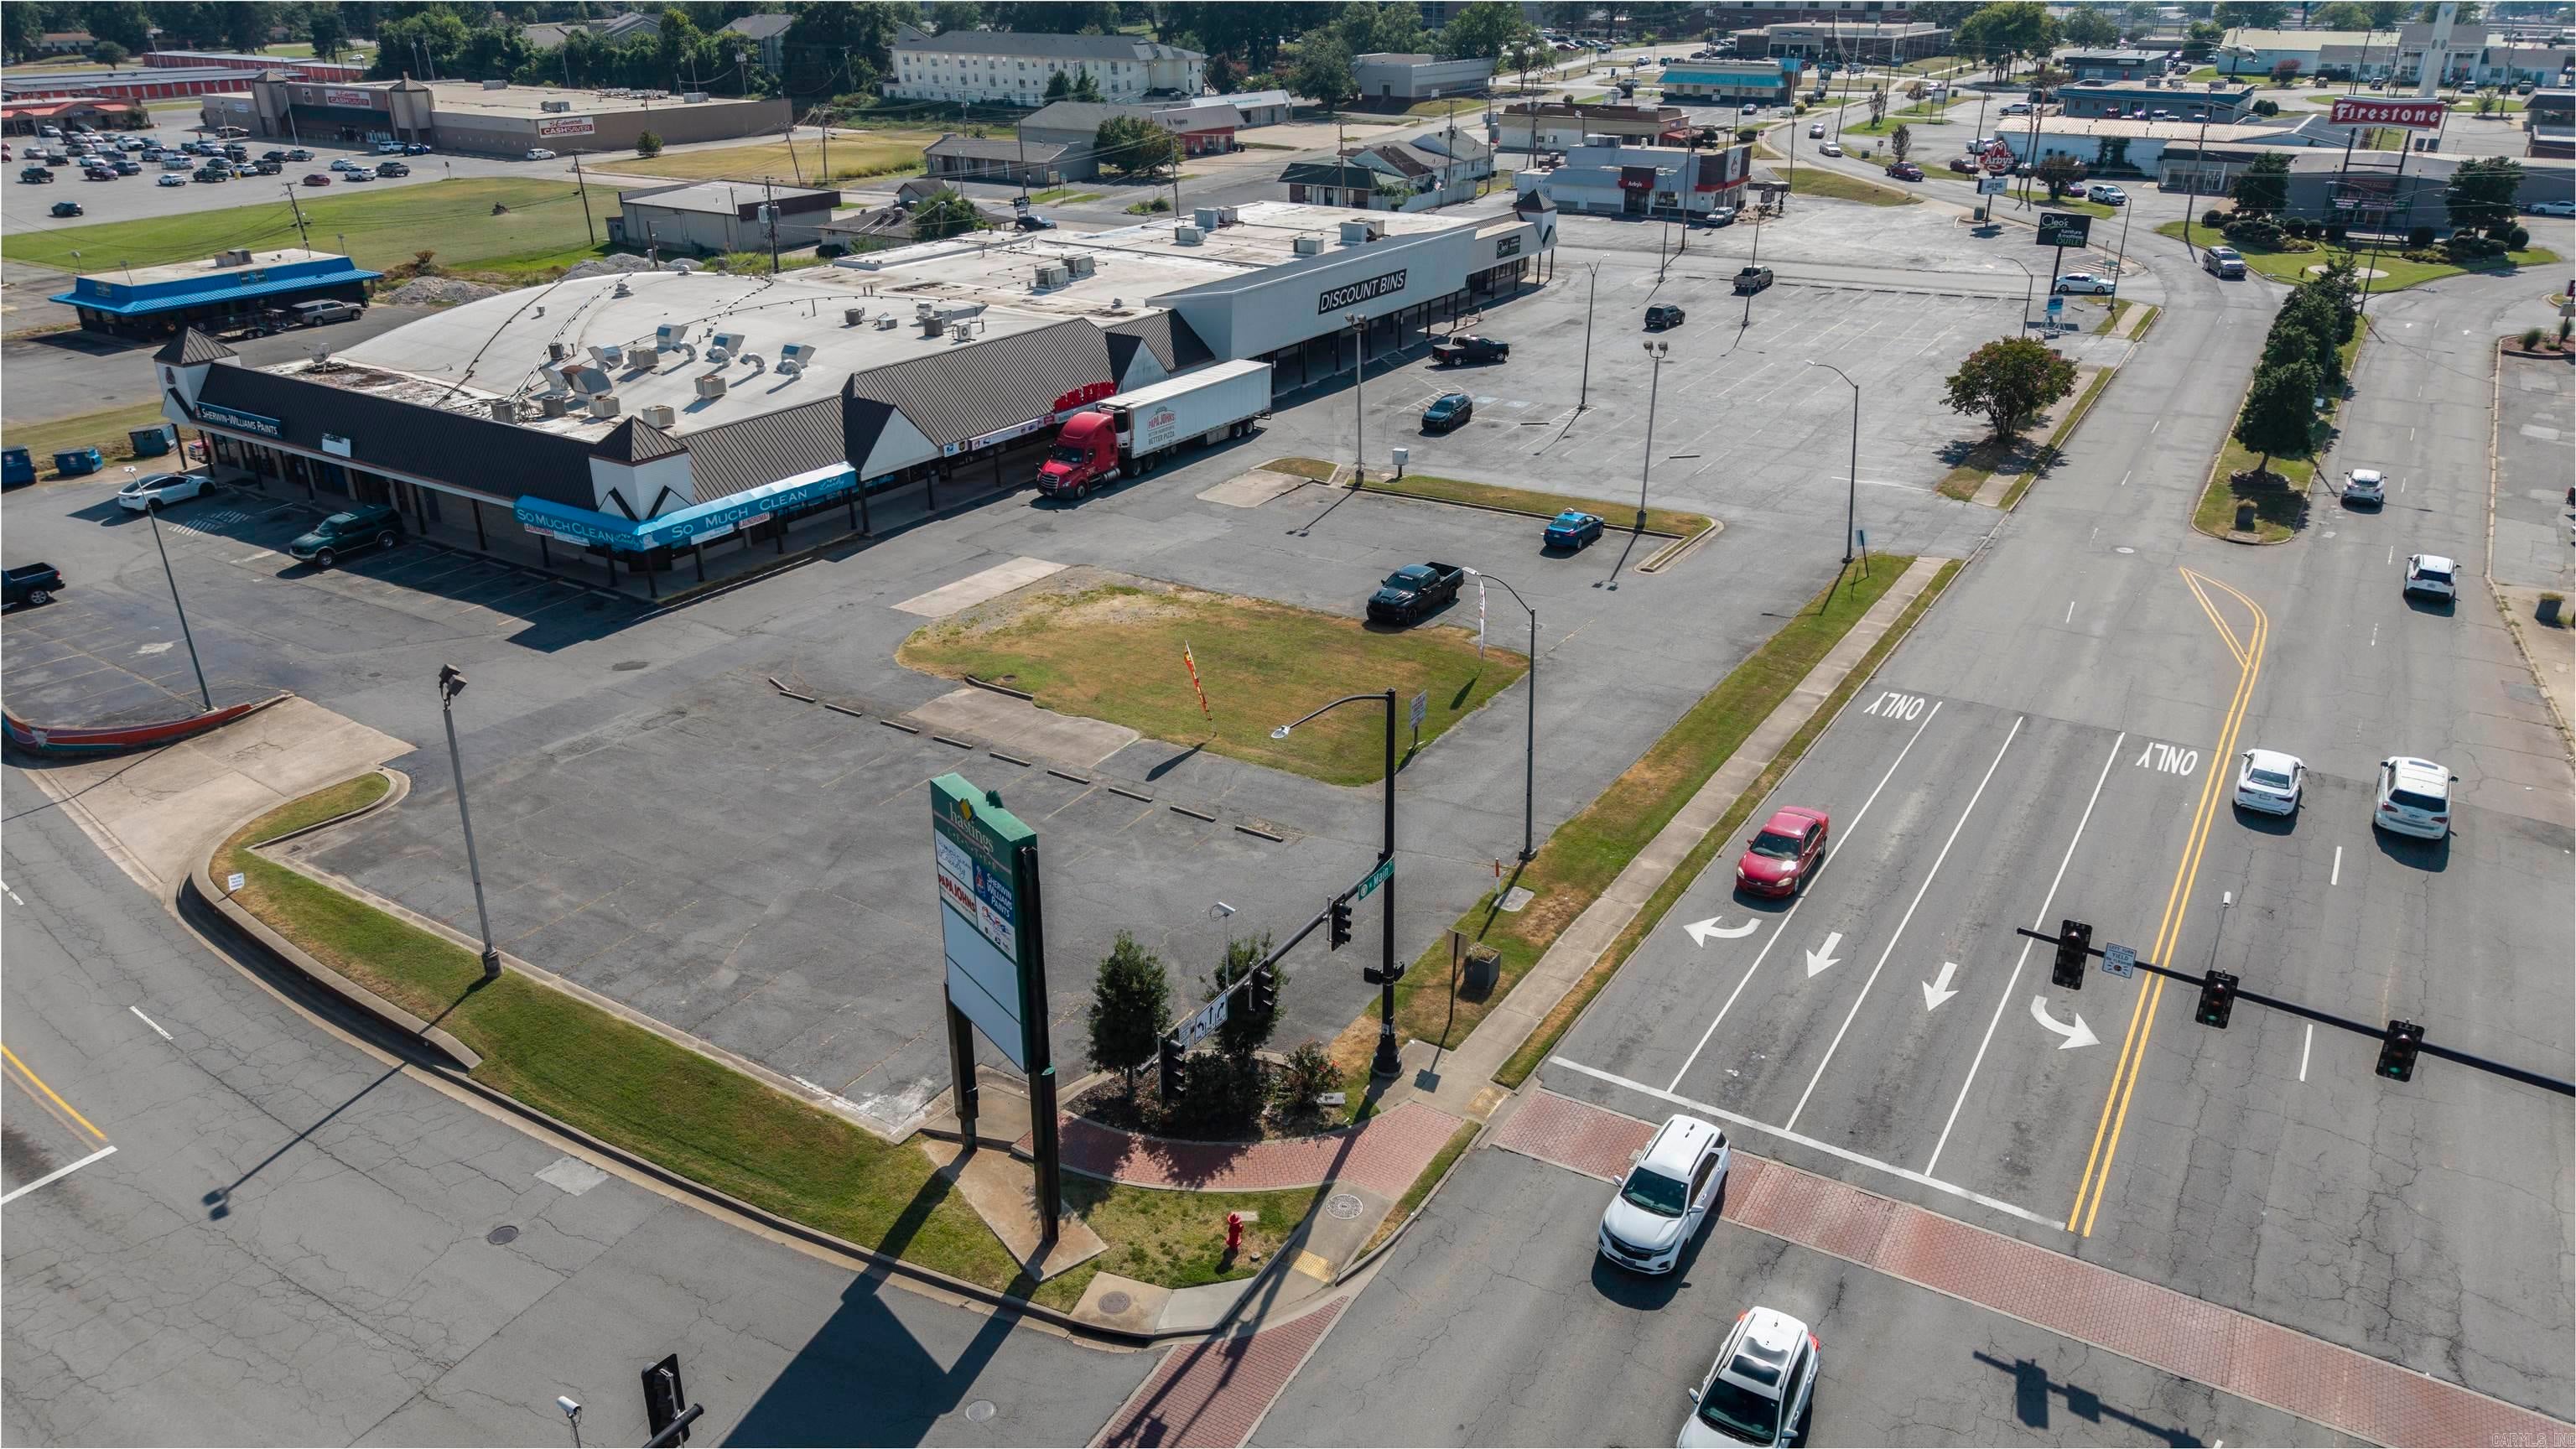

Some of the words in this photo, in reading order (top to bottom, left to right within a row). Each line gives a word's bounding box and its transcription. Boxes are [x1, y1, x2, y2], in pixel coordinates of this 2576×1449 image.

[2336, 103, 2439, 122] Firestone
[2041, 215, 2069, 226] Cleo's
[2056, 238, 2085, 247] OUTLET
[1320, 279, 1379, 311] DISCOUNT
[1379, 273, 1405, 293] BINS
[201, 408, 256, 430] SHERWIN-WILLIAMS
[257, 421, 278, 435] PAINTS
[1148, 434, 1163, 445] BETTER
[517, 509, 534, 522] SO
[535, 513, 570, 532] MUCH
[571, 522, 614, 543] CLEAN
[671, 524, 694, 538] SO
[705, 506, 749, 529] MUCH
[759, 489, 808, 511] CLEAN
[1863, 691, 1925, 721] ONLY
[2136, 742, 2199, 776] ONLY
[950, 802, 994, 854] hastings
[939, 874, 954, 895] PAPA
[987, 873, 1012, 901] SHERWIN
[1374, 867, 1389, 888] Main
[986, 882, 1013, 911] WILLIAMS
[991, 897, 1010, 918] PAINTS
[2112, 953, 2129, 961] YIELD
